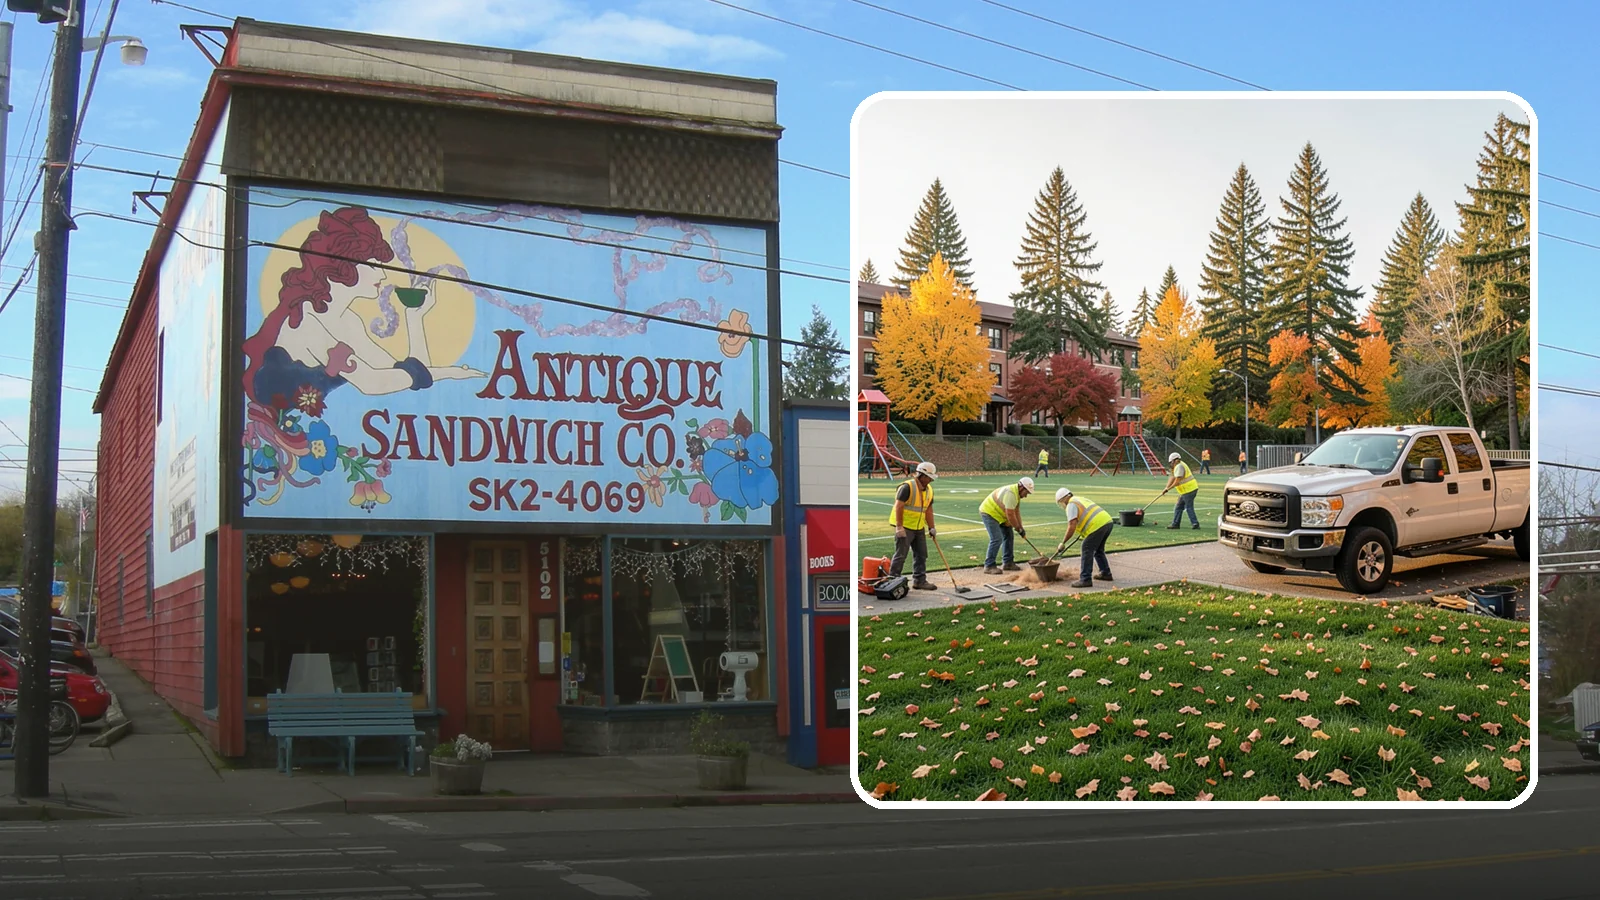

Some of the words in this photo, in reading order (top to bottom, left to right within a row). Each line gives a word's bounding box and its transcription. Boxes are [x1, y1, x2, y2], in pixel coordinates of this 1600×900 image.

[475, 329, 723, 419] ANTIQUE
[362, 409, 604, 466] SANDWICH
[617, 422, 685, 468] CO.
[468, 477, 645, 513] SK2-4069
[540, 542, 551, 600] 5102
[809, 555, 835, 569] BOOKS
